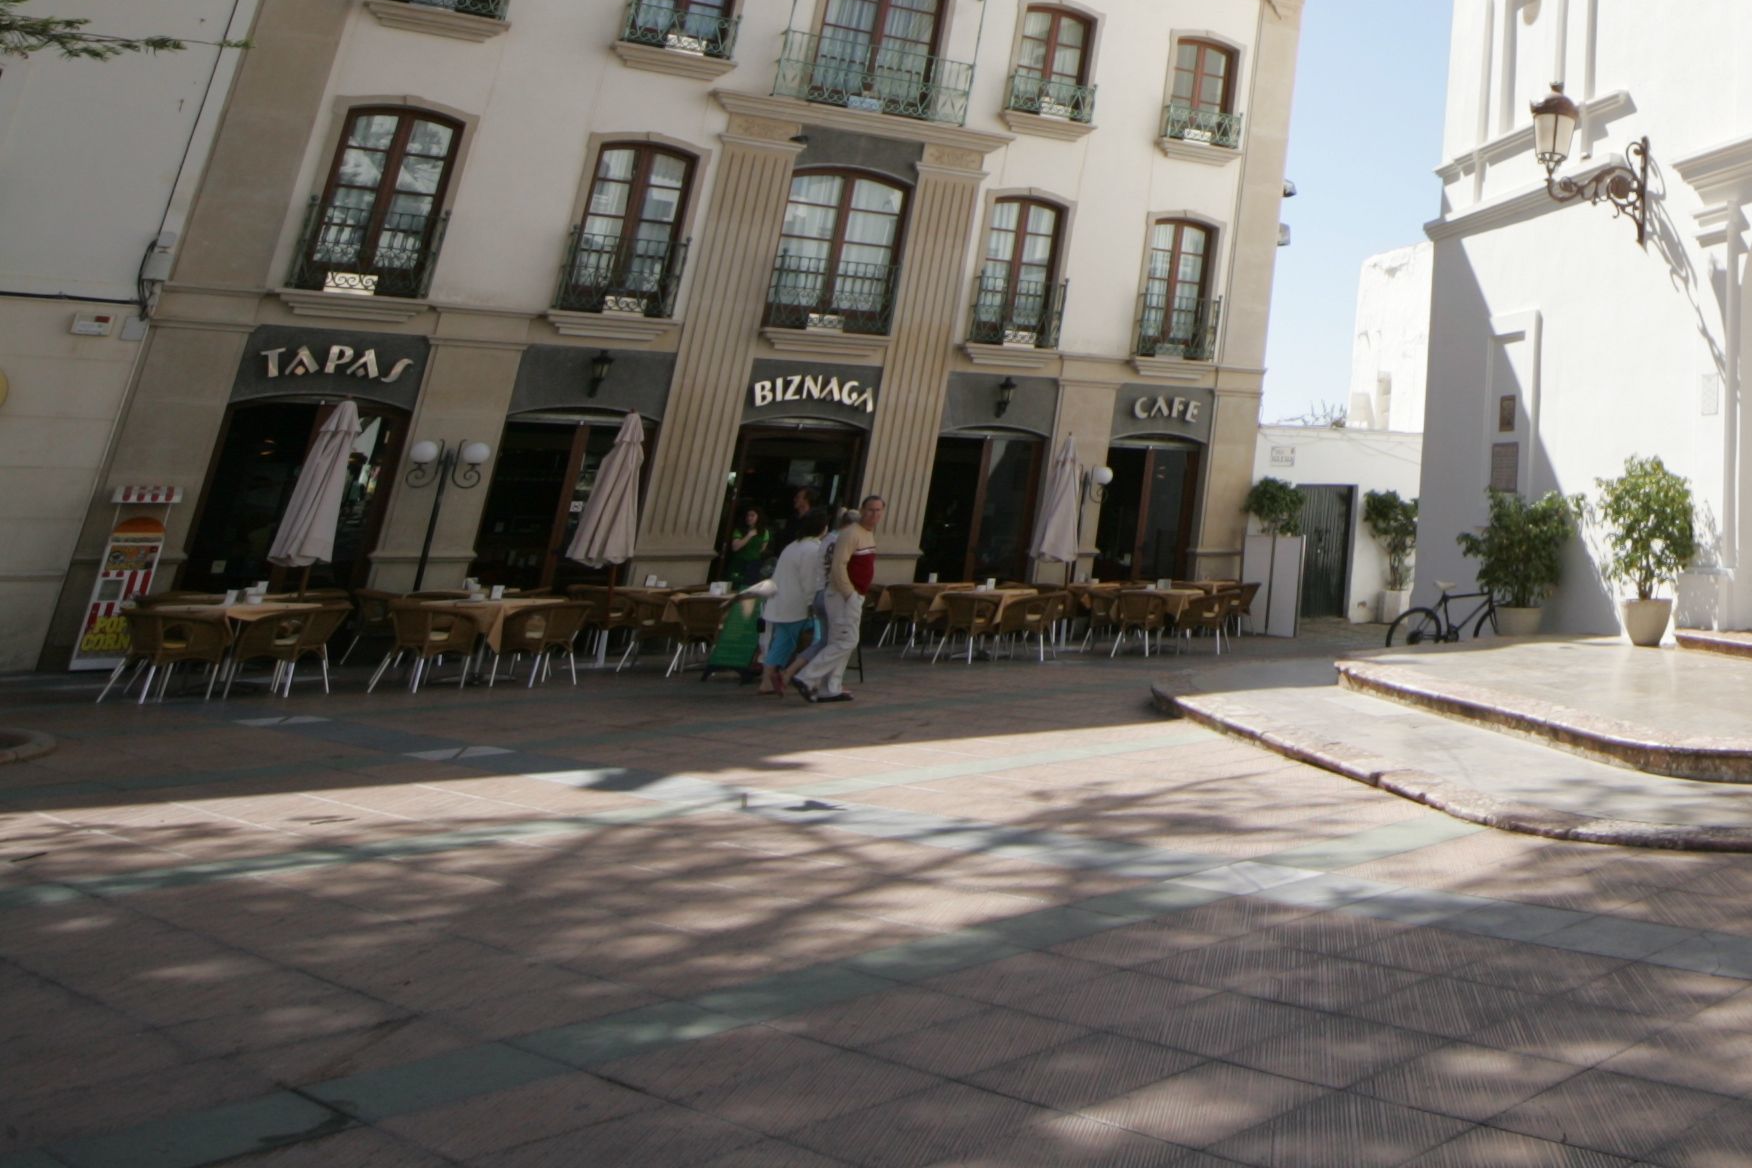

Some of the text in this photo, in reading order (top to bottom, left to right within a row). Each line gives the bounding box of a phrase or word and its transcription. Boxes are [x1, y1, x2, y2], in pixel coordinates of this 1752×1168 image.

[260, 344, 414, 383] TAPAS
[754, 374, 874, 414] BIZNAGA
[1134, 395, 1201, 423] CAFE
